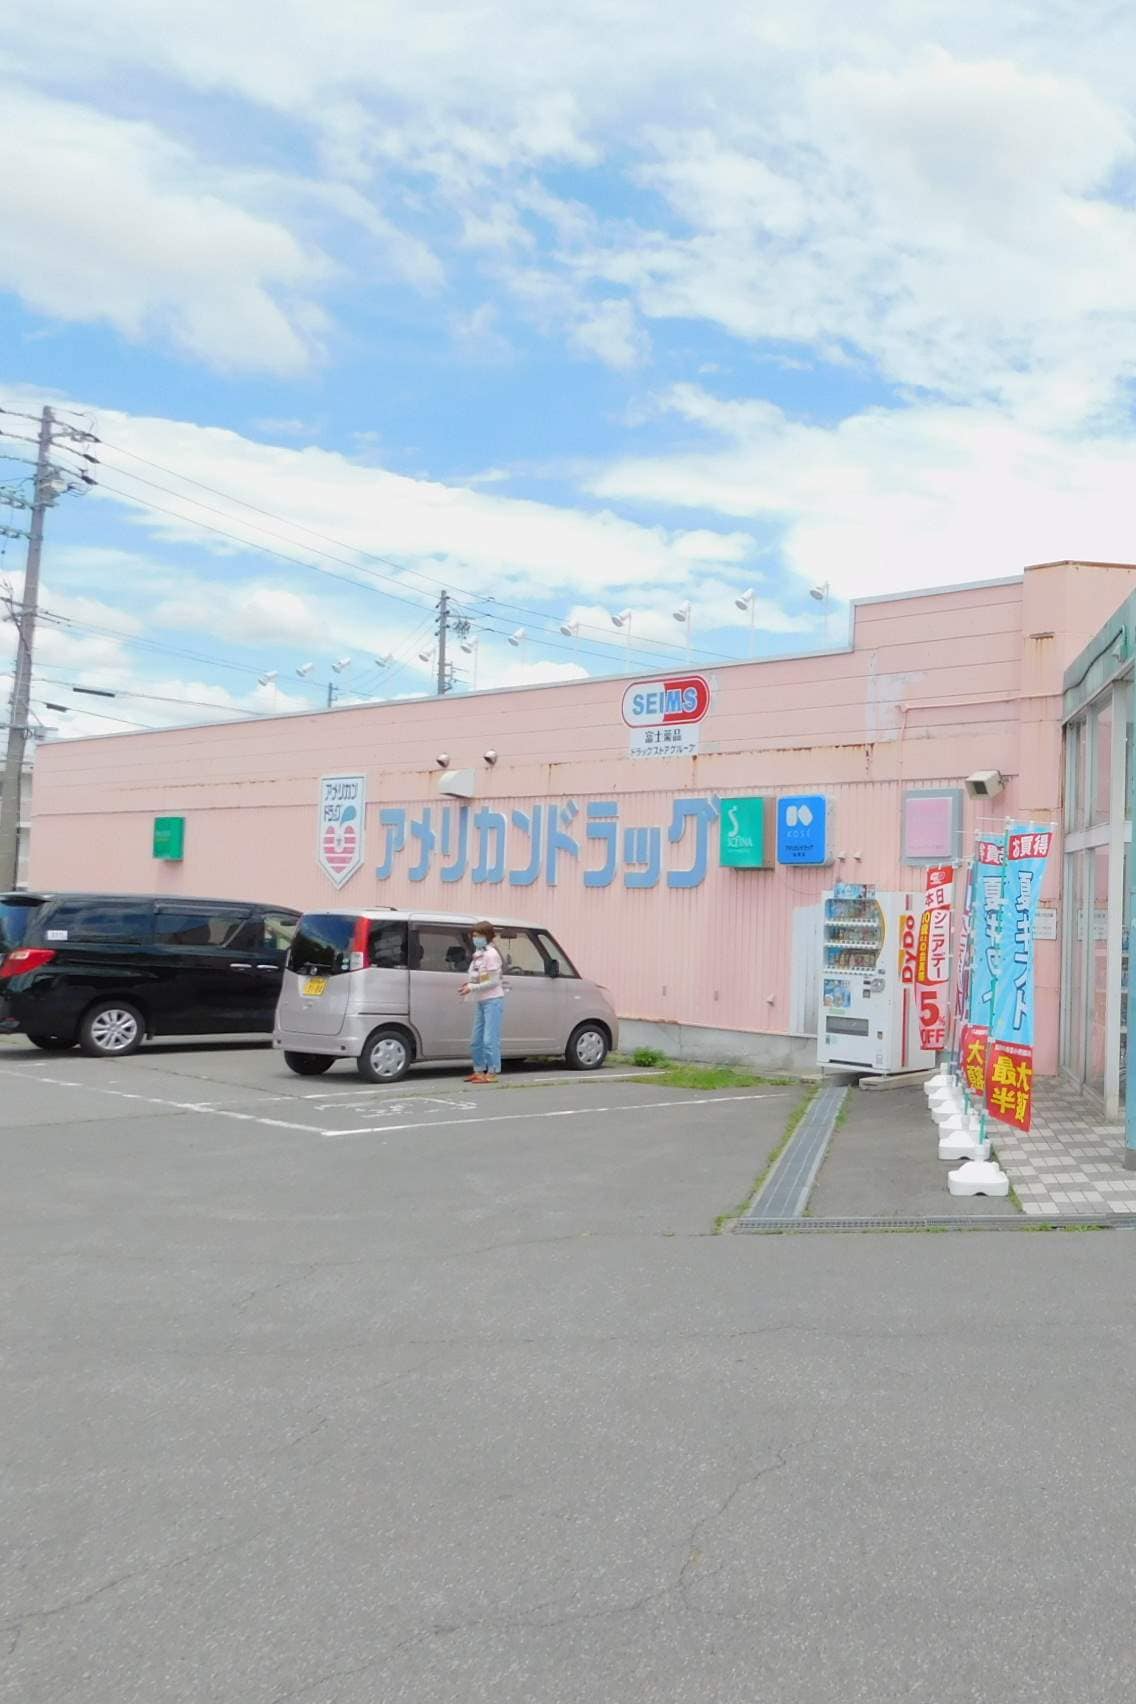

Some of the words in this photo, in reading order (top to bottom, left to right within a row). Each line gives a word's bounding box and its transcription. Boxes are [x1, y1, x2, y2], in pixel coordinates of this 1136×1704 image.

[632, 687, 698, 715] SEIMS
[644, 729, 682, 743] 富士薬品
[325, 782, 358, 800] アメリカン
[374, 792, 721, 888] アメリカンドラッグ
[1012, 834, 1049, 859] お買得
[924, 888, 945, 907] 本日
[902, 914, 918, 984] DyDo
[931, 911, 948, 978] シニアデー
